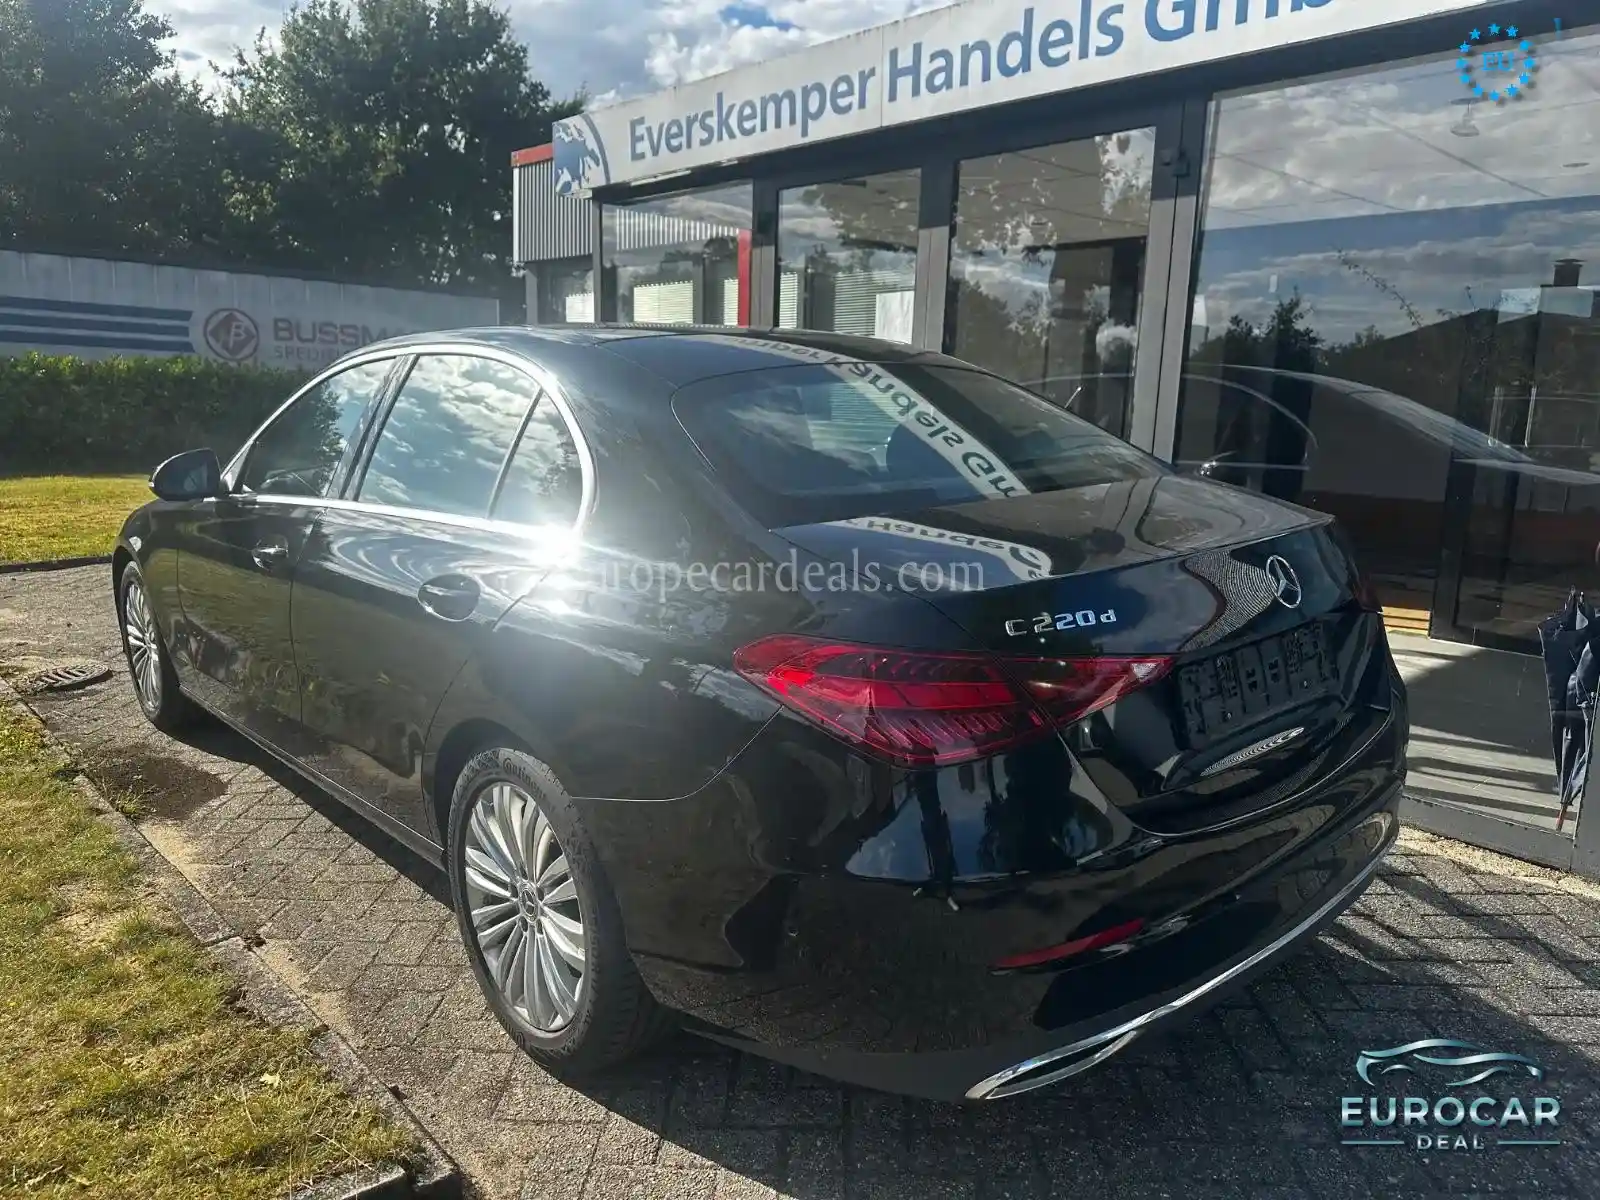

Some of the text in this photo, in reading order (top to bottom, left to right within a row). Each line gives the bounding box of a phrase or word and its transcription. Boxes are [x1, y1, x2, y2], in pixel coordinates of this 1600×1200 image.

[629, 0, 1333, 161] Everskemper Handels Gm
[272, 316, 405, 347] BUSSM
[1005, 619, 1027, 636] C
